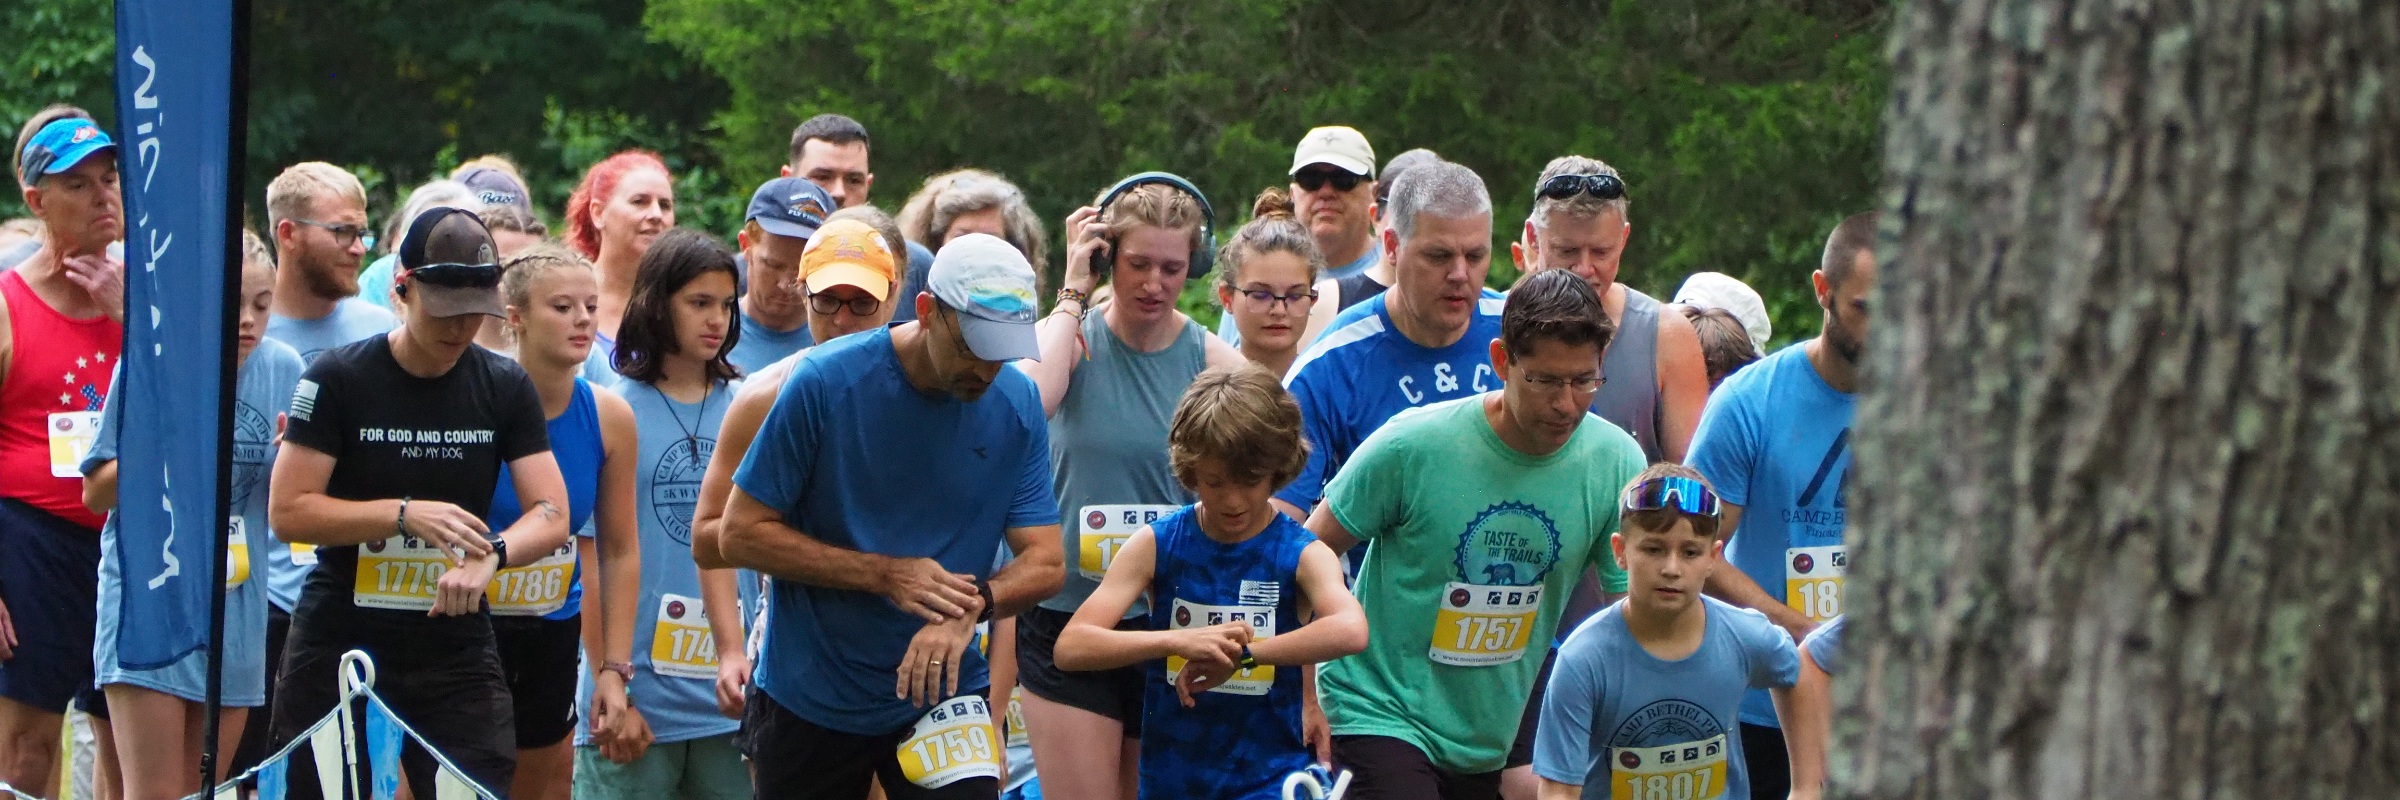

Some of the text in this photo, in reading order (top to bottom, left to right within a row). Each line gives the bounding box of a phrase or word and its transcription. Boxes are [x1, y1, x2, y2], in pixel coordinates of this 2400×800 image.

[1399, 362, 1491, 404] C & C
[360, 429, 495, 444] FOR GOD AND COUNTRY
[402, 446, 463, 460] AND MY DOG
[658, 449, 679, 479] CAMP
[663, 489, 700, 499] 5K WA
[1781, 509, 1831, 526] CAMP
[1484, 530, 1530, 548] TASTE OF
[1488, 547, 1544, 565] THE TRAILS
[375, 561, 447, 596] 1779
[494, 567, 563, 603] 1786
[1798, 580, 1842, 618] 18
[671, 628, 718, 664] 174
[1456, 616, 1523, 651] 1757
[1645, 703, 1701, 722] BETHEL
[911, 726, 992, 773] 1759
[1627, 768, 1712, 800] 1807
